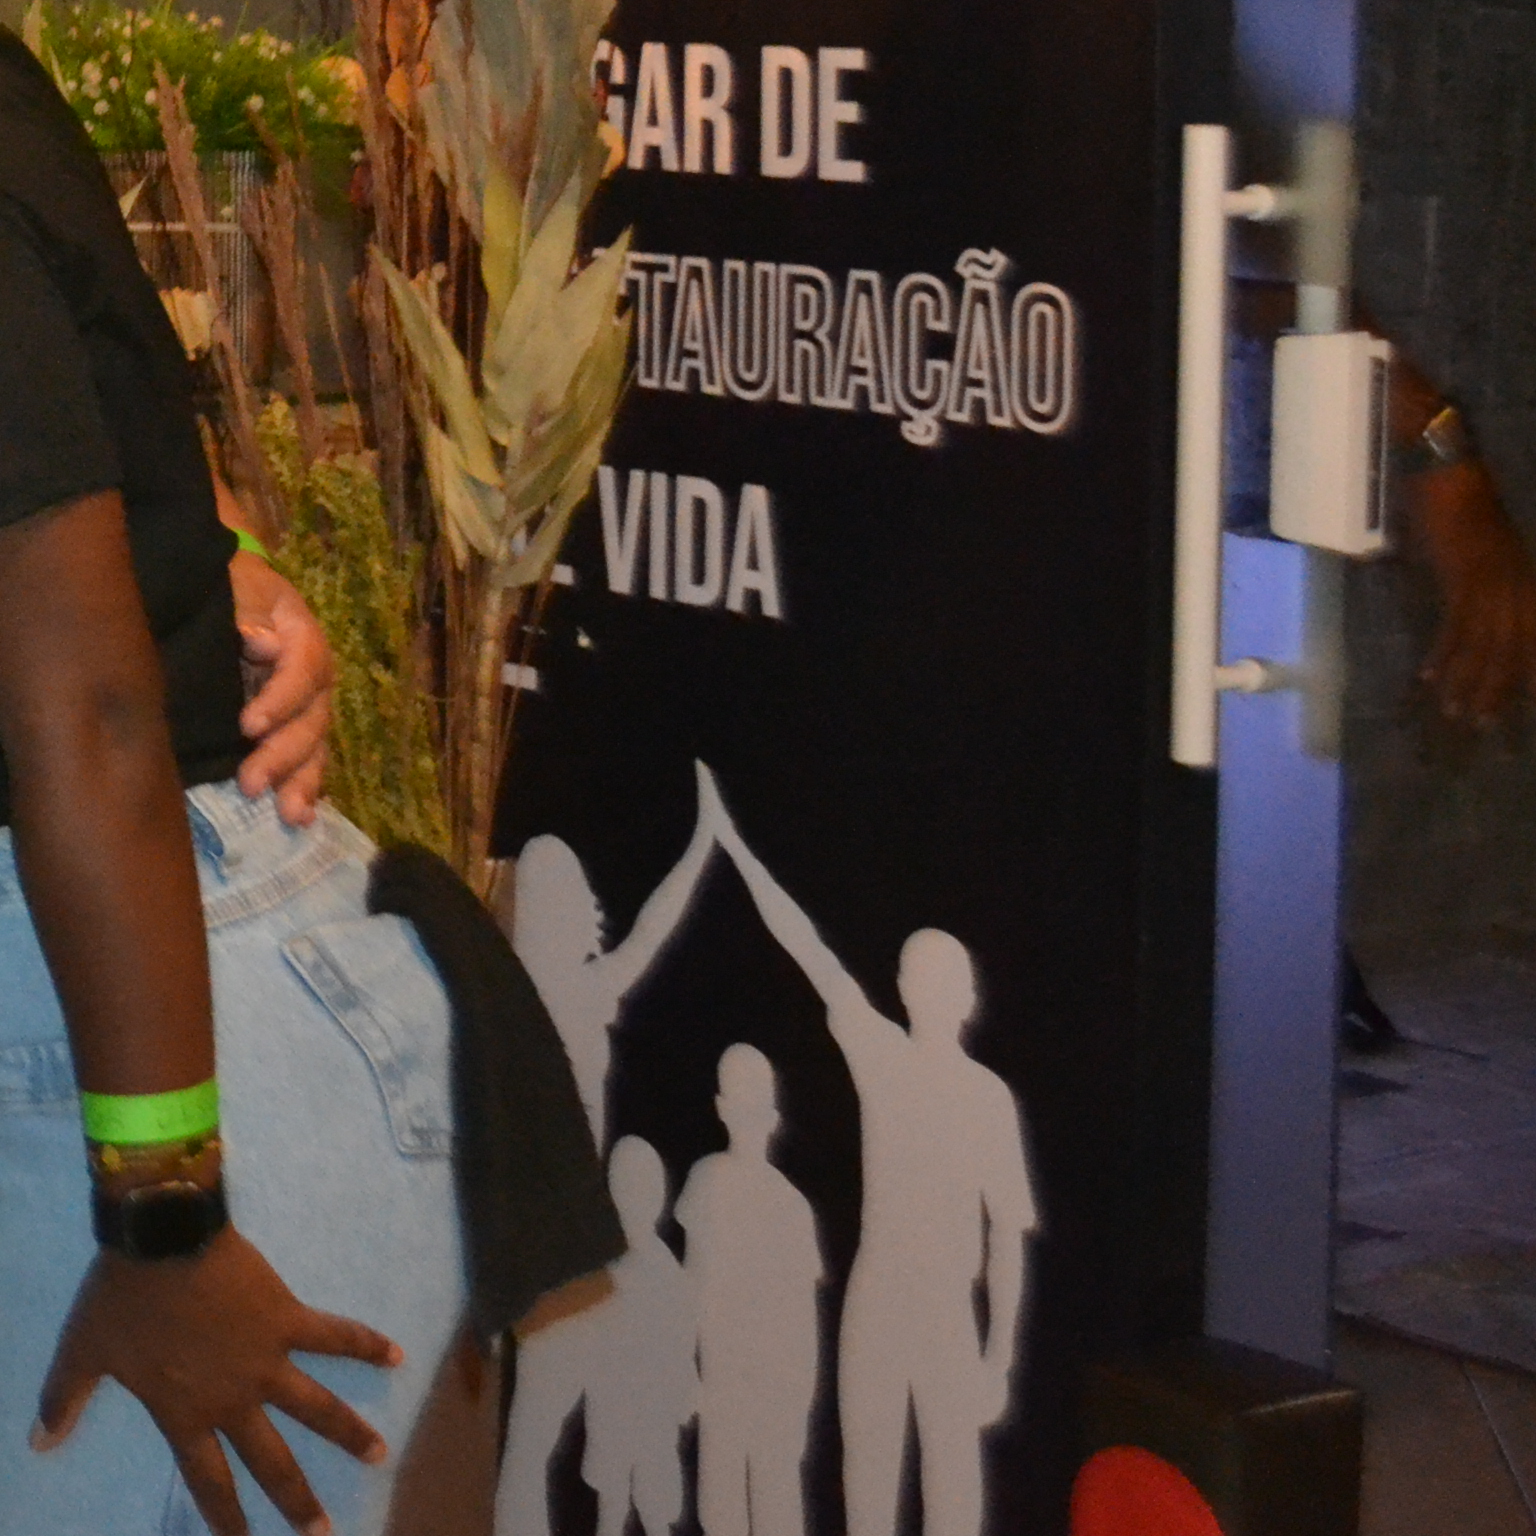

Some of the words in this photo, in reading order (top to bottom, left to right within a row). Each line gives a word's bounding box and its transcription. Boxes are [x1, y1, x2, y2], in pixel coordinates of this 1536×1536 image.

[590, 38, 734, 177] GAR
[760, 44, 870, 184] DE
[592, 247, 1081, 448] TAURAÇÃO
[597, 465, 783, 620] VIDA
